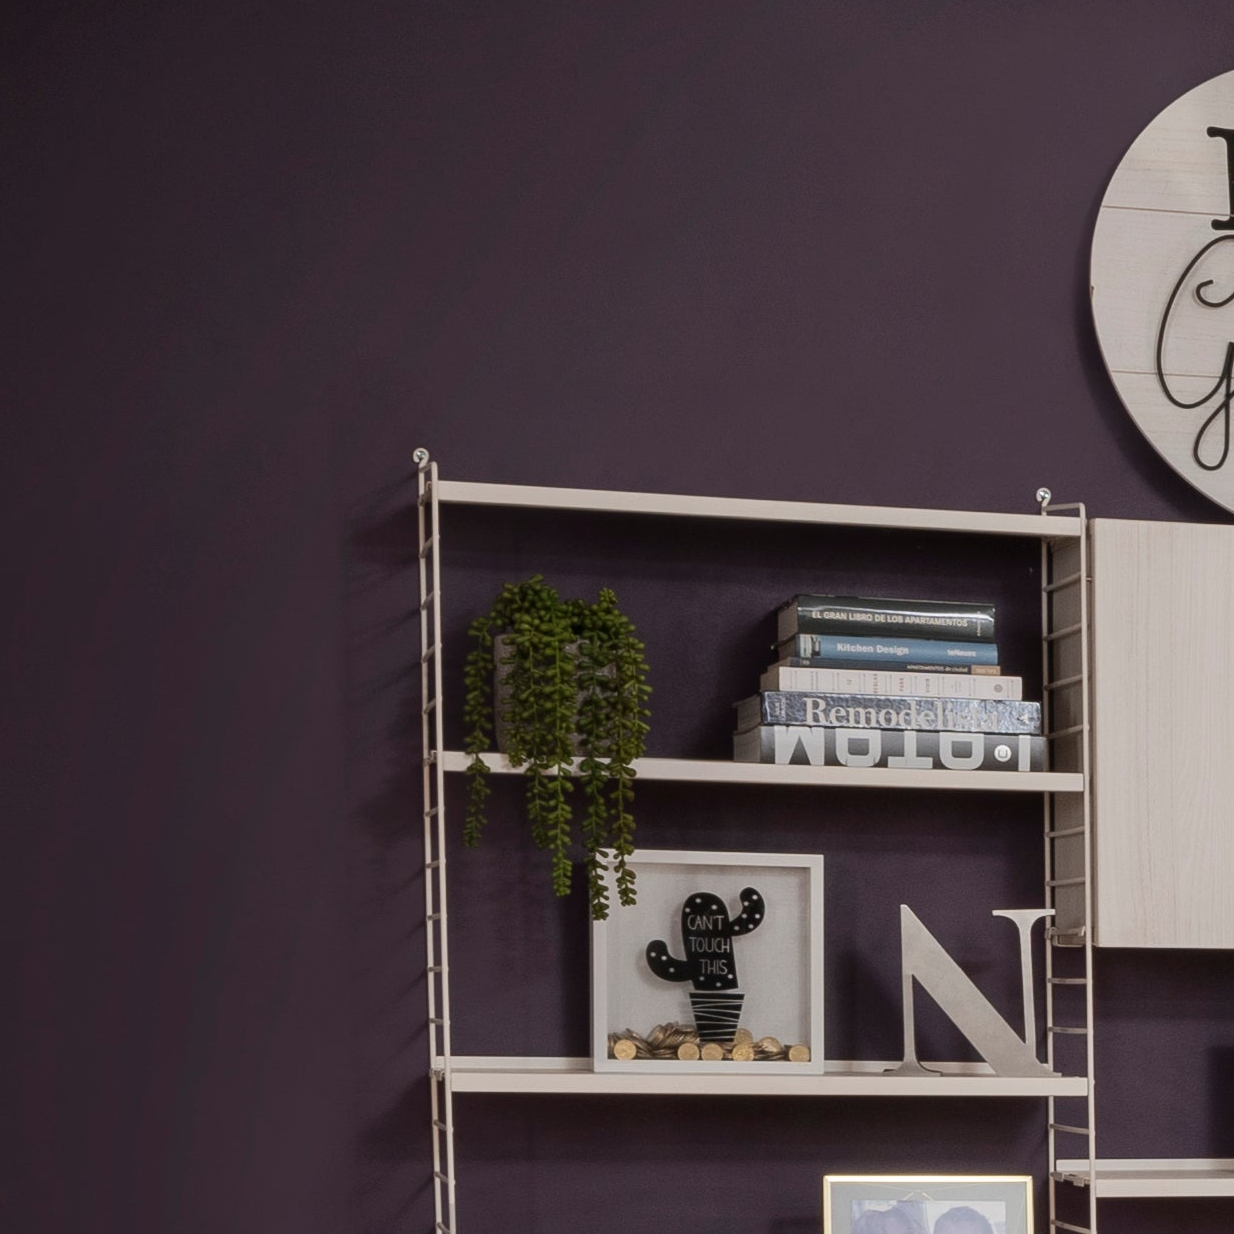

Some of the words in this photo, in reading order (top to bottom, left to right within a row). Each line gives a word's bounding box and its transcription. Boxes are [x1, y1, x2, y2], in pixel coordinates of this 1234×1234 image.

[812, 610, 821, 619] EL
[823, 611, 847, 621] GRAN
[848, 612, 873, 622] LIBRO
[874, 614, 885, 623] DE
[887, 615, 904, 624] LOS
[905, 615, 968, 628] APARTAMENTOS
[837, 642, 874, 653] Kitchen
[876, 643, 909, 656] Design
[802, 697, 1001, 733] Remodelista
[687, 914, 725, 932] CAN'T
[689, 936, 730, 954] TOUCH
[700, 958, 728, 976] THIS
[883, 904, 1062, 1077] N
